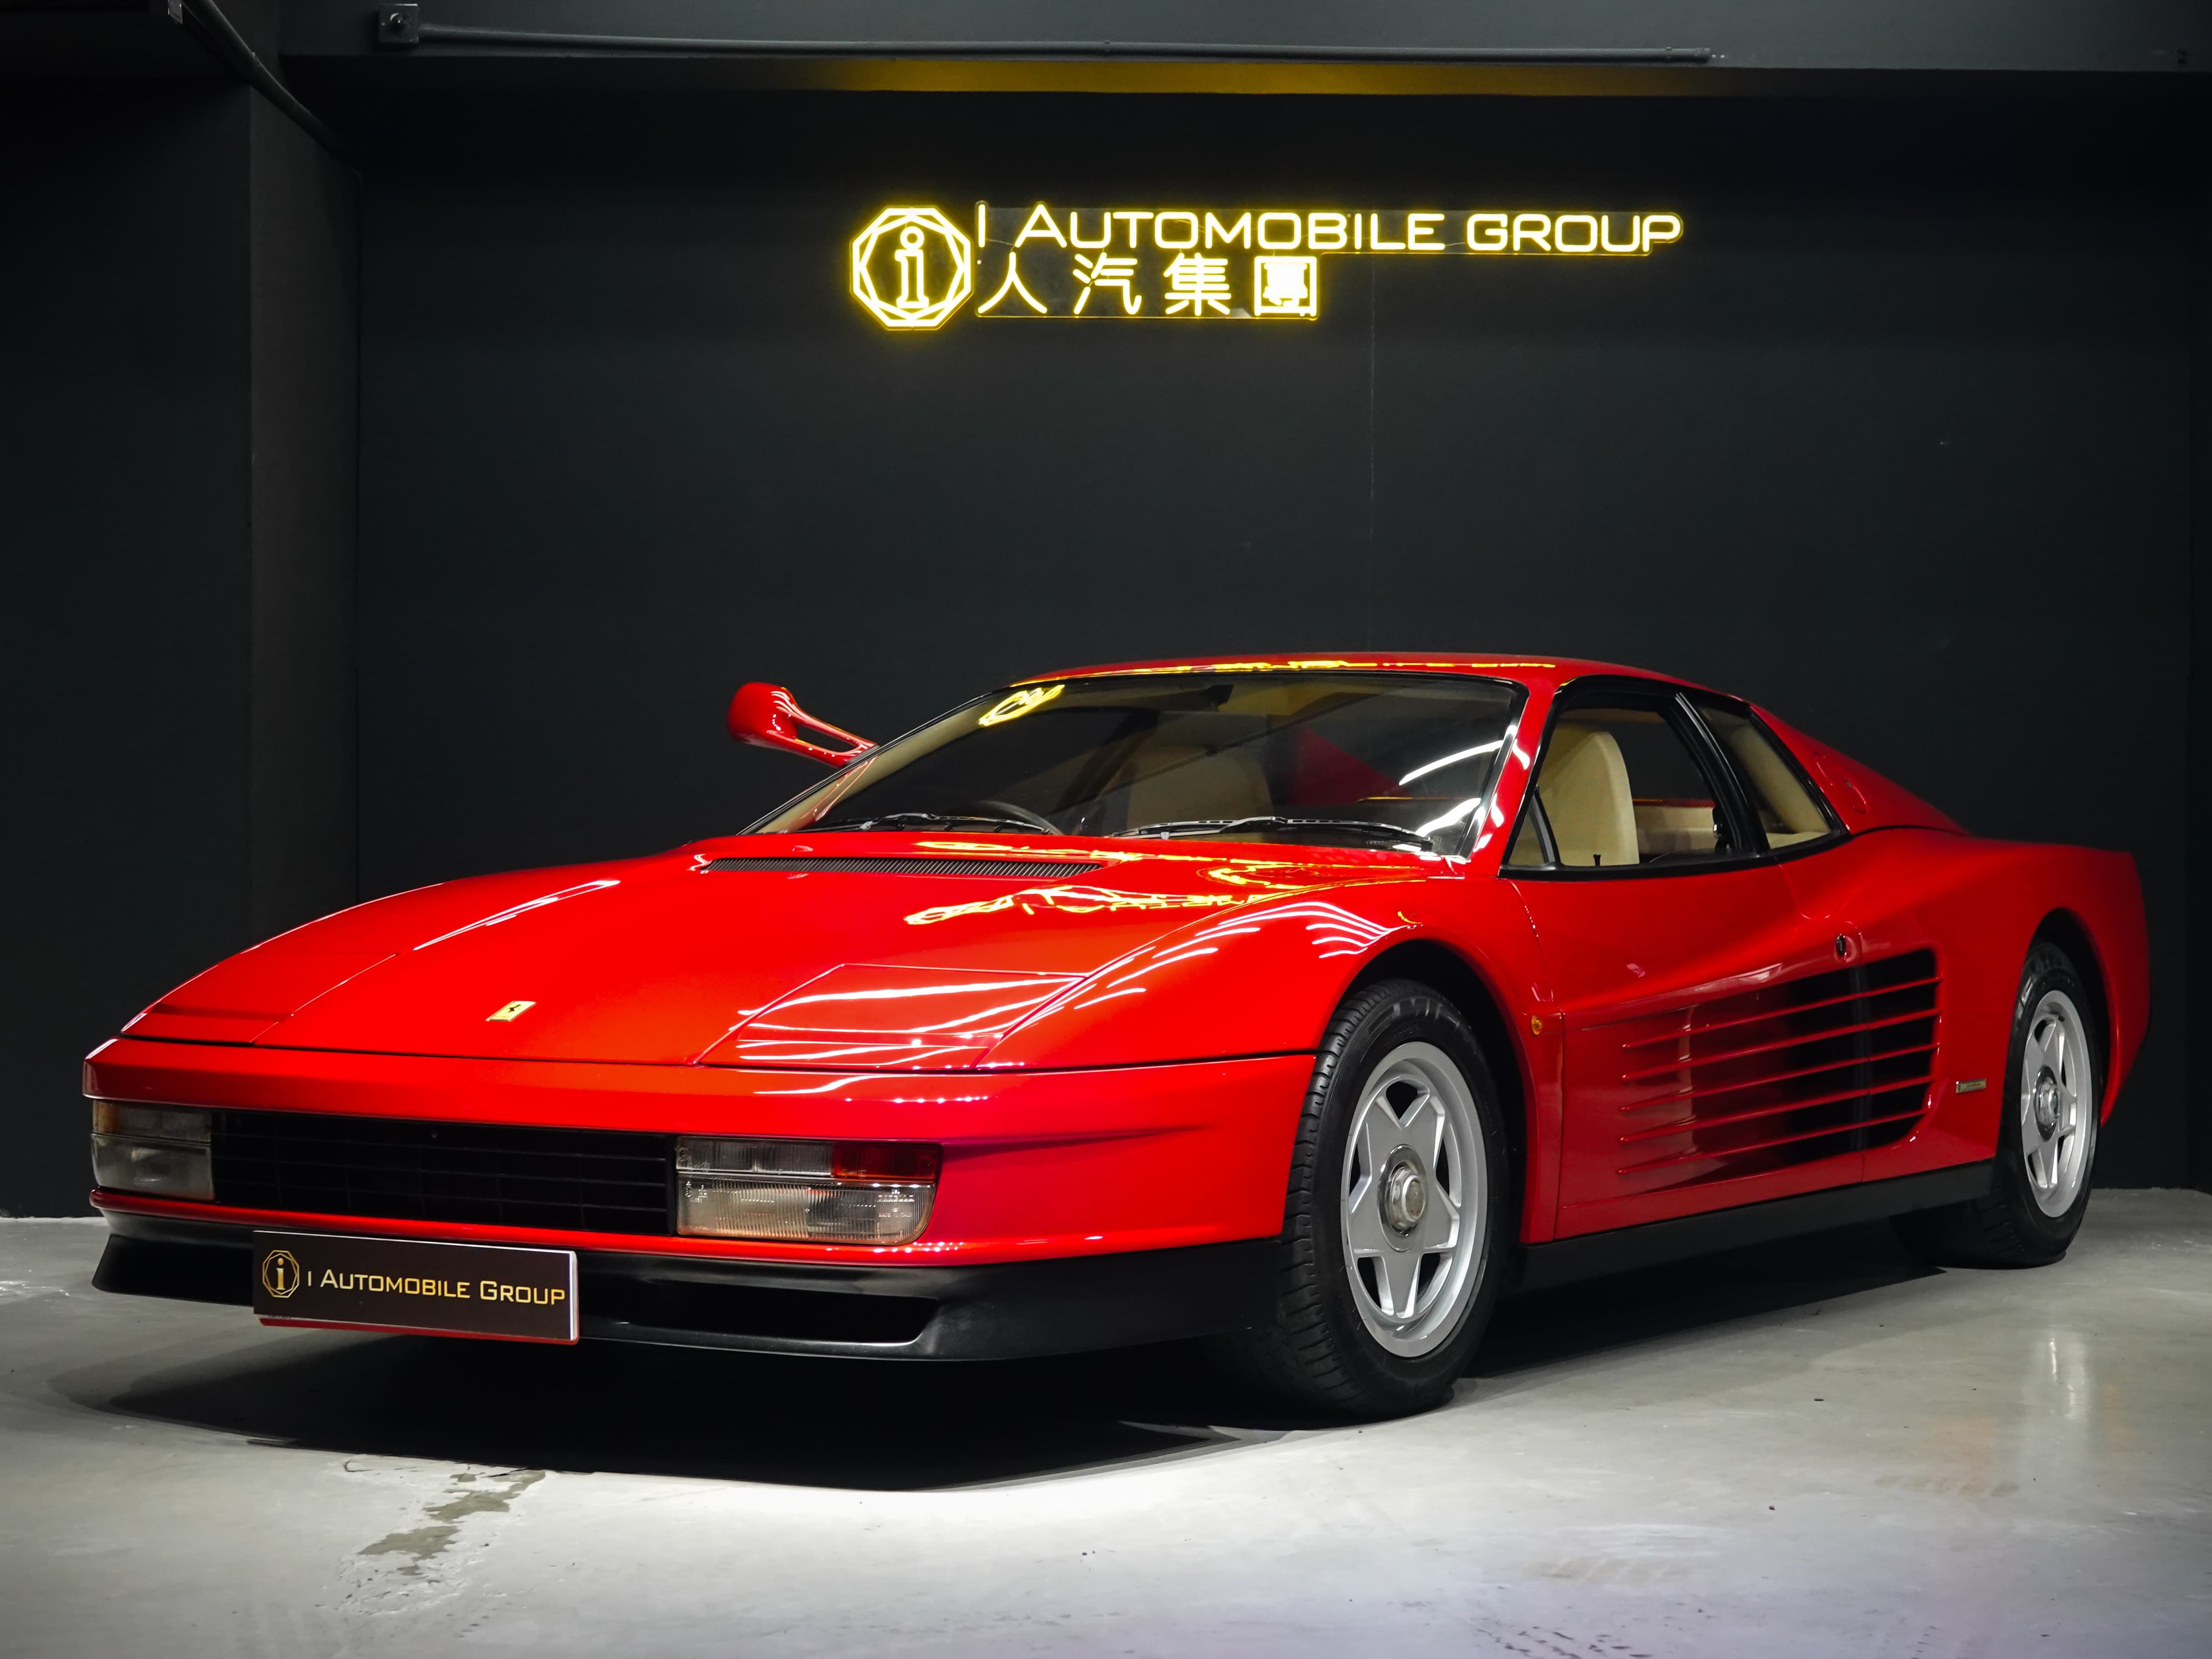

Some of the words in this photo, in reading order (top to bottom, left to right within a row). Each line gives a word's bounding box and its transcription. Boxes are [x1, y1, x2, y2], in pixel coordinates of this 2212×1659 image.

[1014, 204, 1446, 250] AUTOMOBILE
[1466, 213, 1681, 252] GROUP
[319, 1268, 471, 1299] AUTOMOBILE
[479, 1280, 566, 1306] GROUP
